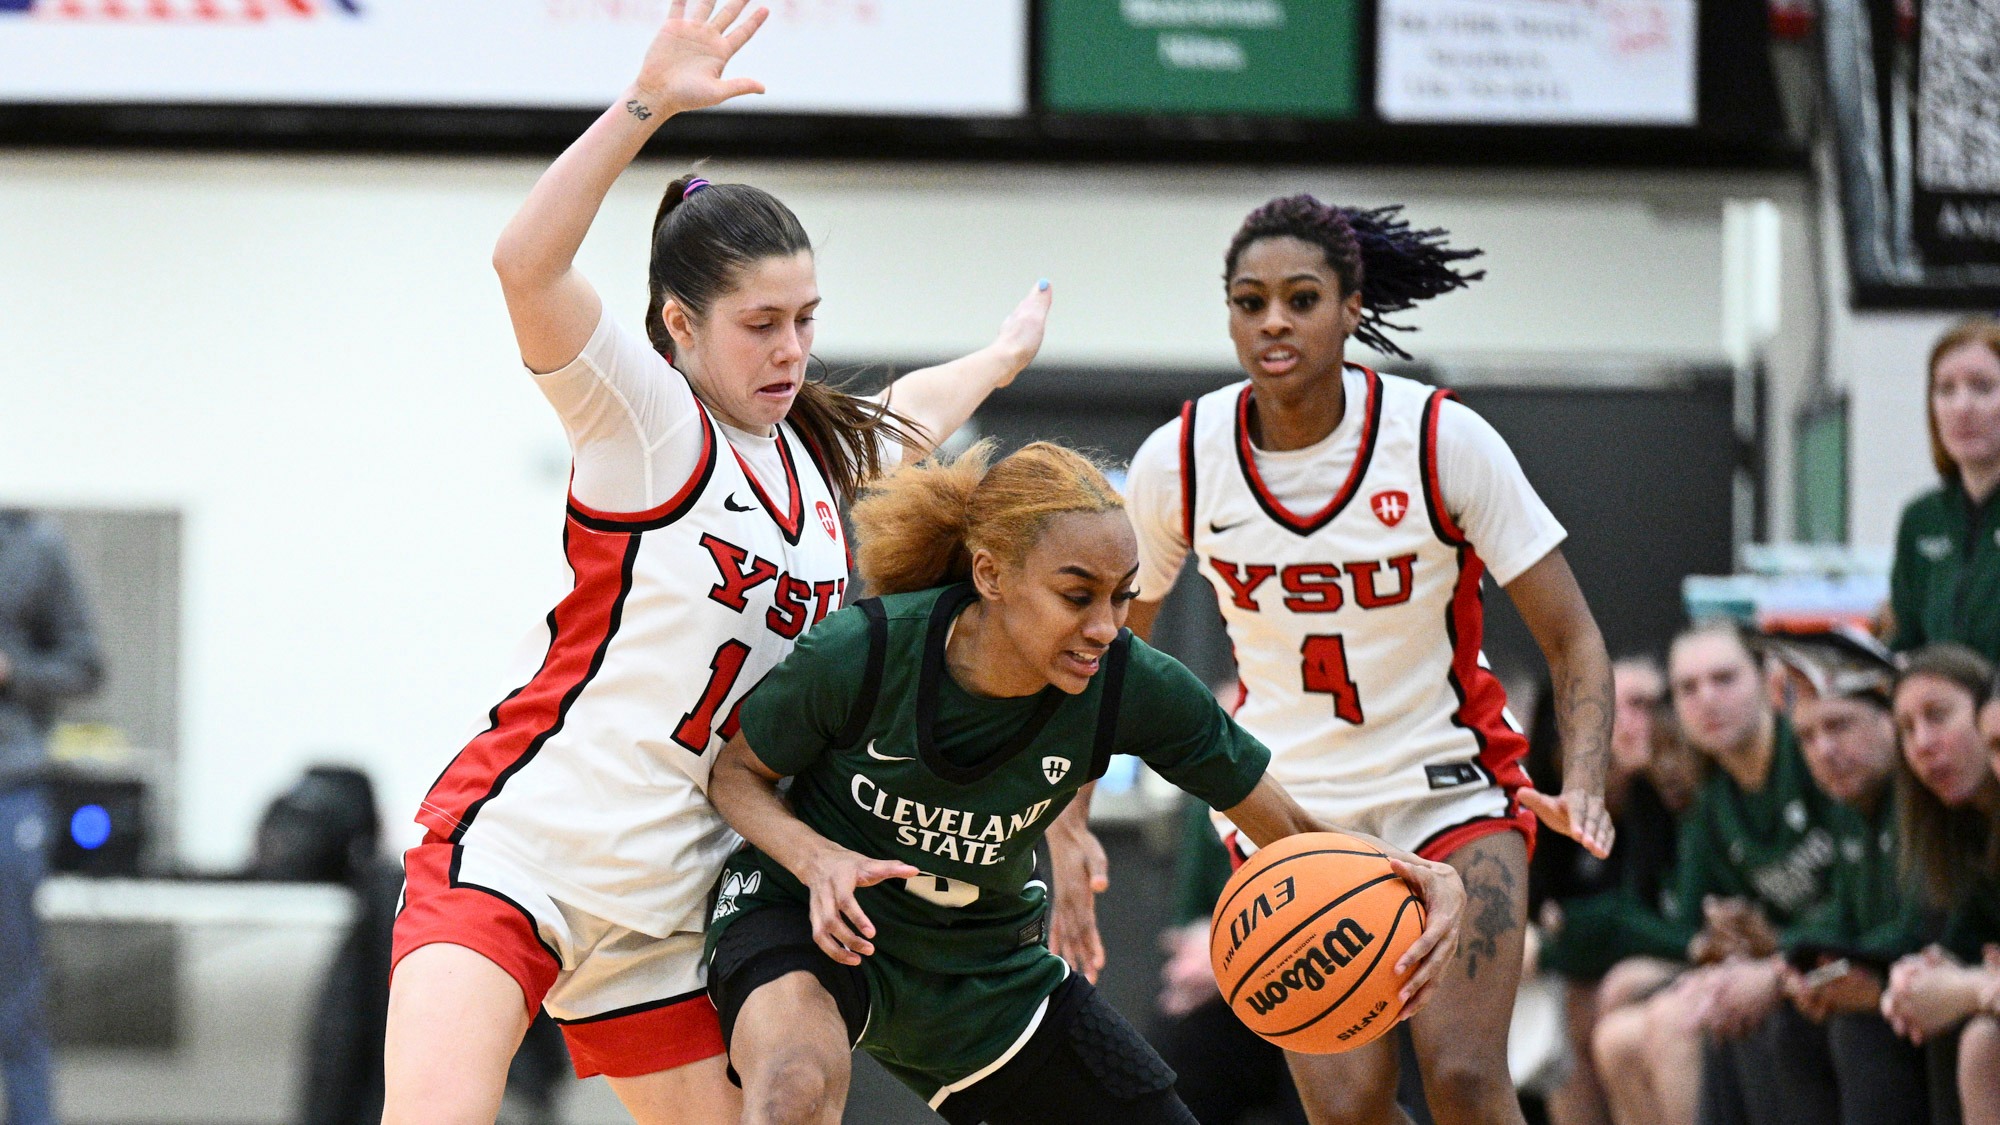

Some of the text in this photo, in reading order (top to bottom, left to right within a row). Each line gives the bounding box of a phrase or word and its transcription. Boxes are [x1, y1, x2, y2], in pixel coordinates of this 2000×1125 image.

[1209, 553, 1417, 613] YSU
[1300, 633, 1364, 724] 4
[851, 773, 1052, 844] CLEVELAND
[896, 825, 1001, 865] STATE
[1230, 875, 1296, 951] EVO
[1293, 933, 1317, 955] INDOOR
[1245, 918, 1376, 1016] Wilson
[1336, 1010, 1379, 1041] NFHS
